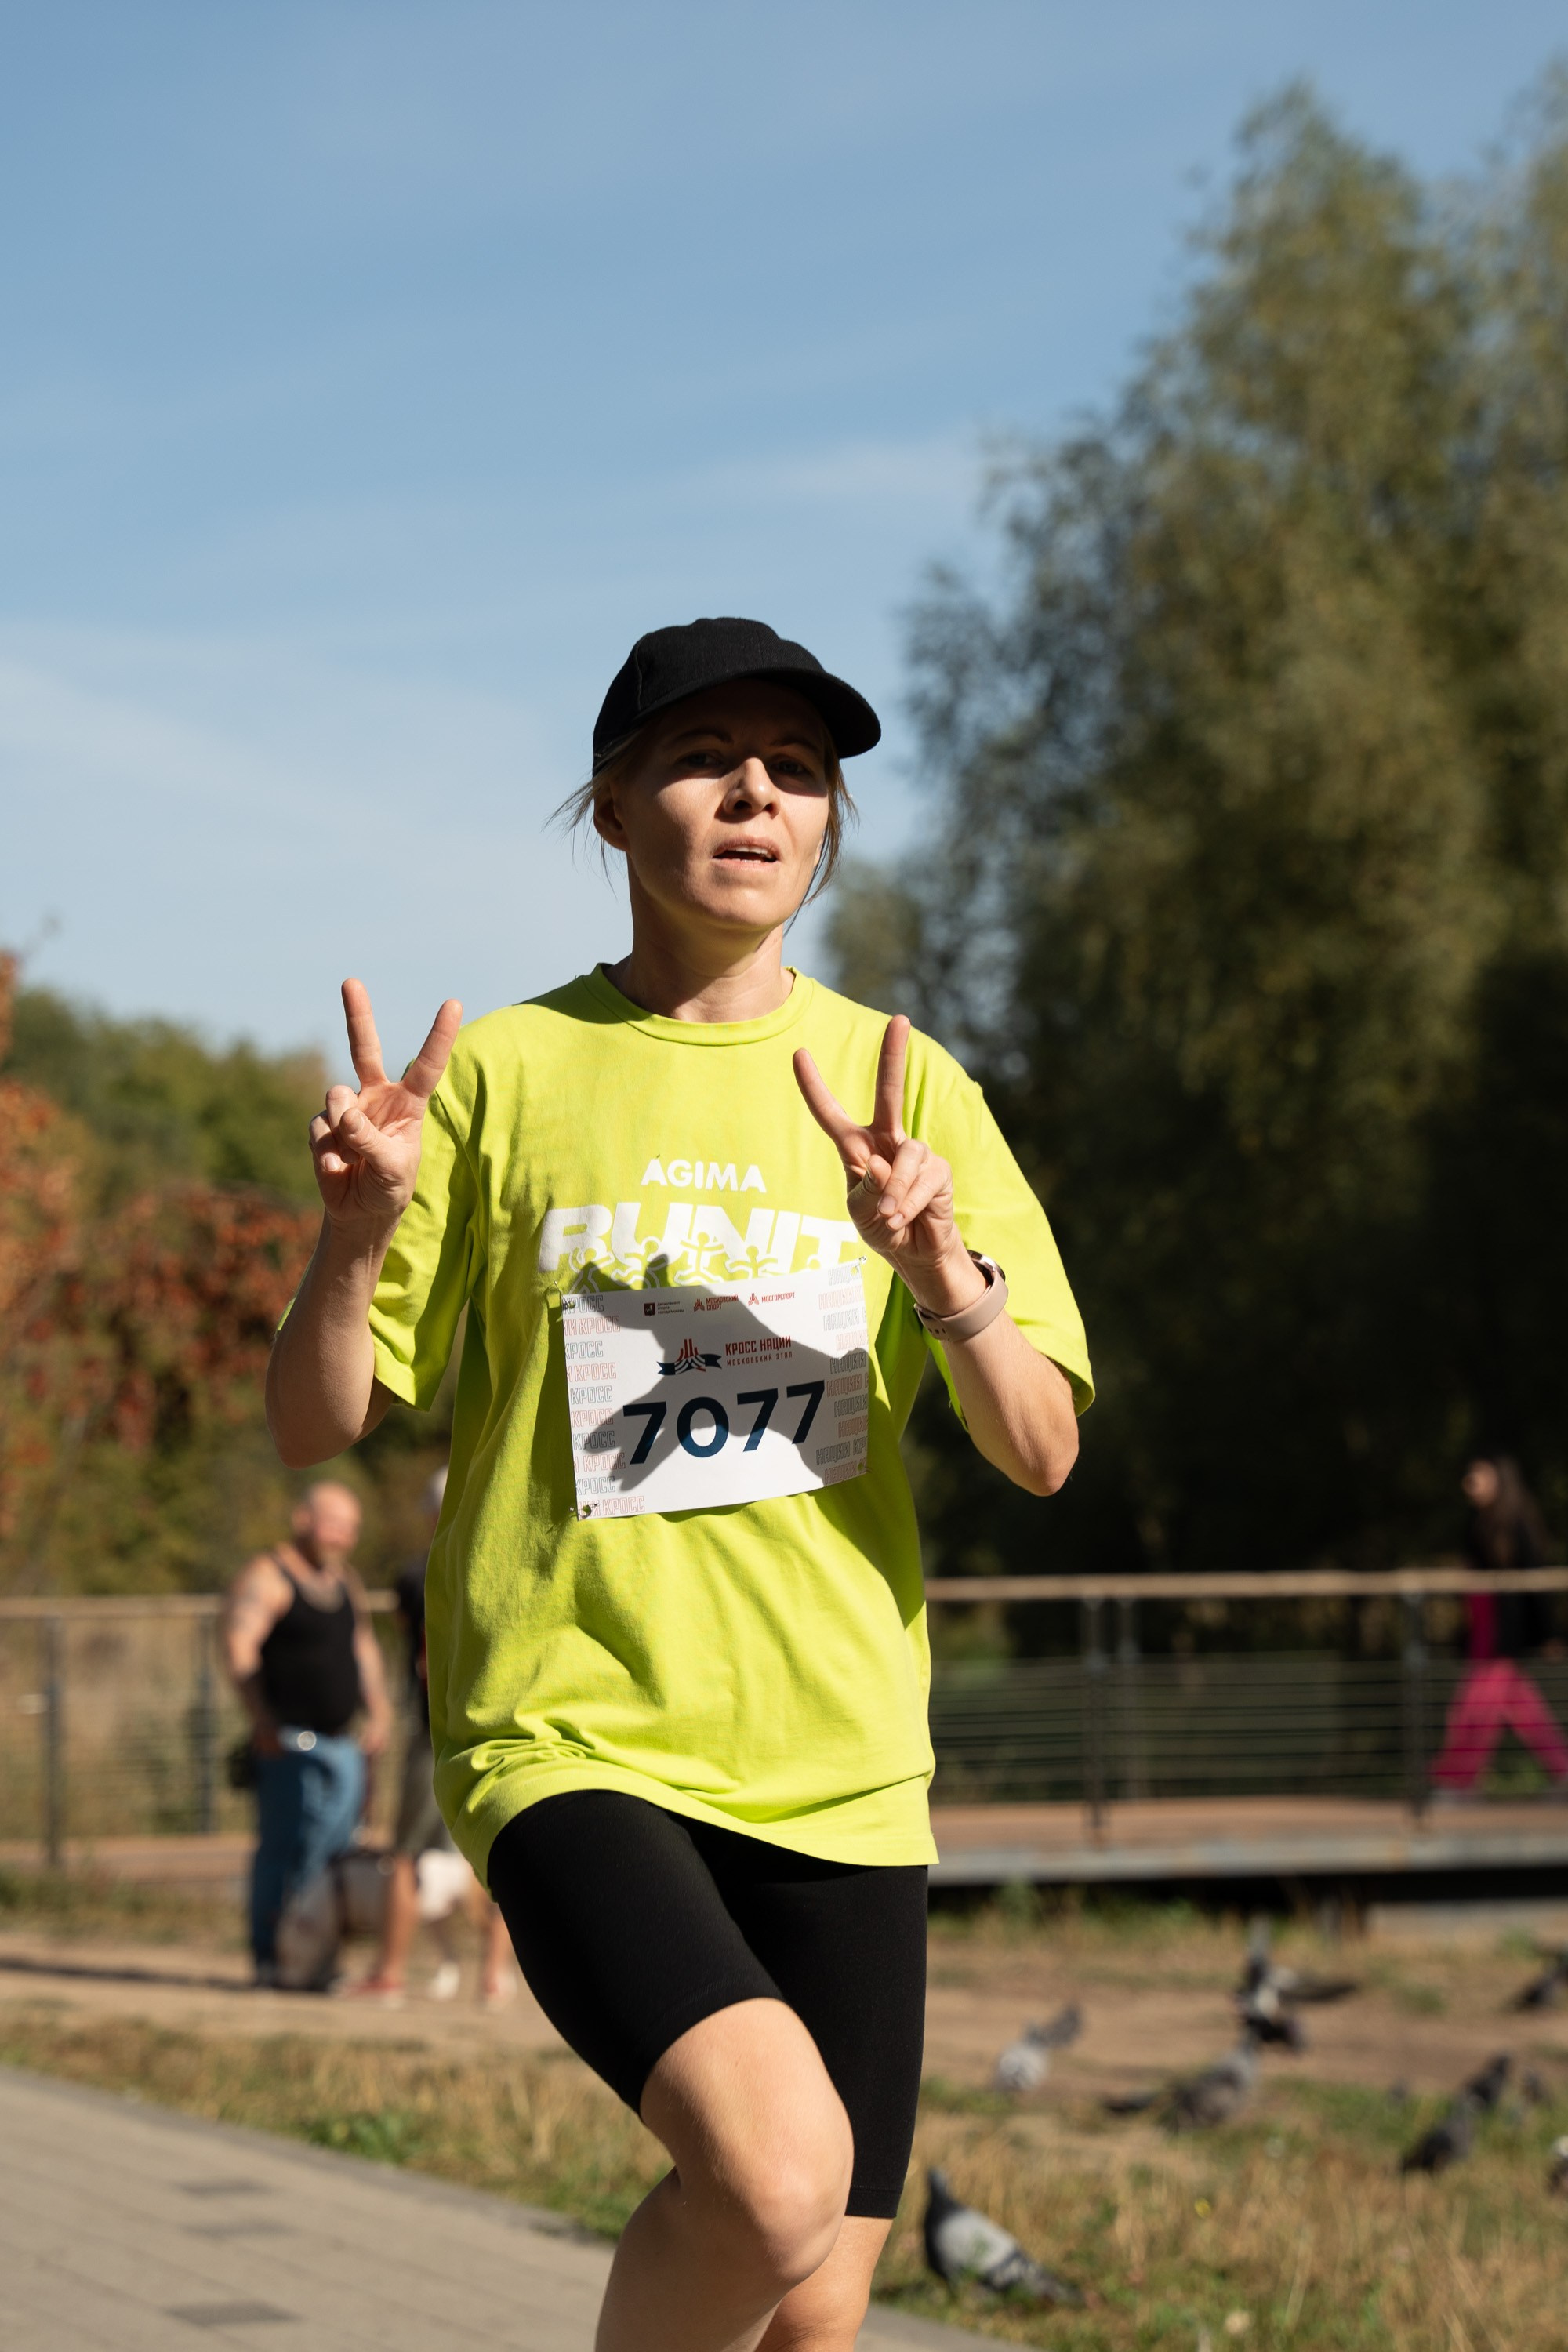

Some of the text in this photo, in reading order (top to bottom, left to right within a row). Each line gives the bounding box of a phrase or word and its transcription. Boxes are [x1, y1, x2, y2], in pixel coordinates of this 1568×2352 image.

[761, 1292, 795, 1302] МОСГОРСПОРТ
[579, 1316, 621, 1335] КРОСС
[823, 1308, 860, 1331] НАЦИИ
[725, 1336, 792, 1356] КРОСС НАЦИИ
[775, 1351, 793, 1360] ЭТАП
[574, 1363, 617, 1382] КРОСС
[829, 1351, 866, 1374] НАЦИИ
[569, 1385, 613, 1405] КРОСС
[826, 1374, 862, 1397] НАЦИИ
[833, 1393, 868, 1417] НАЦИИ
[570, 1408, 614, 1428] КРОСС
[623, 1380, 825, 1465] 7077
[572, 1431, 615, 1450] КРОСС
[583, 1452, 626, 1472] КРОСС
[815, 1441, 851, 1465] НАЦИИ
[824, 1461, 857, 1485] НАЦИИ
[602, 1496, 645, 1515] КРОСС
